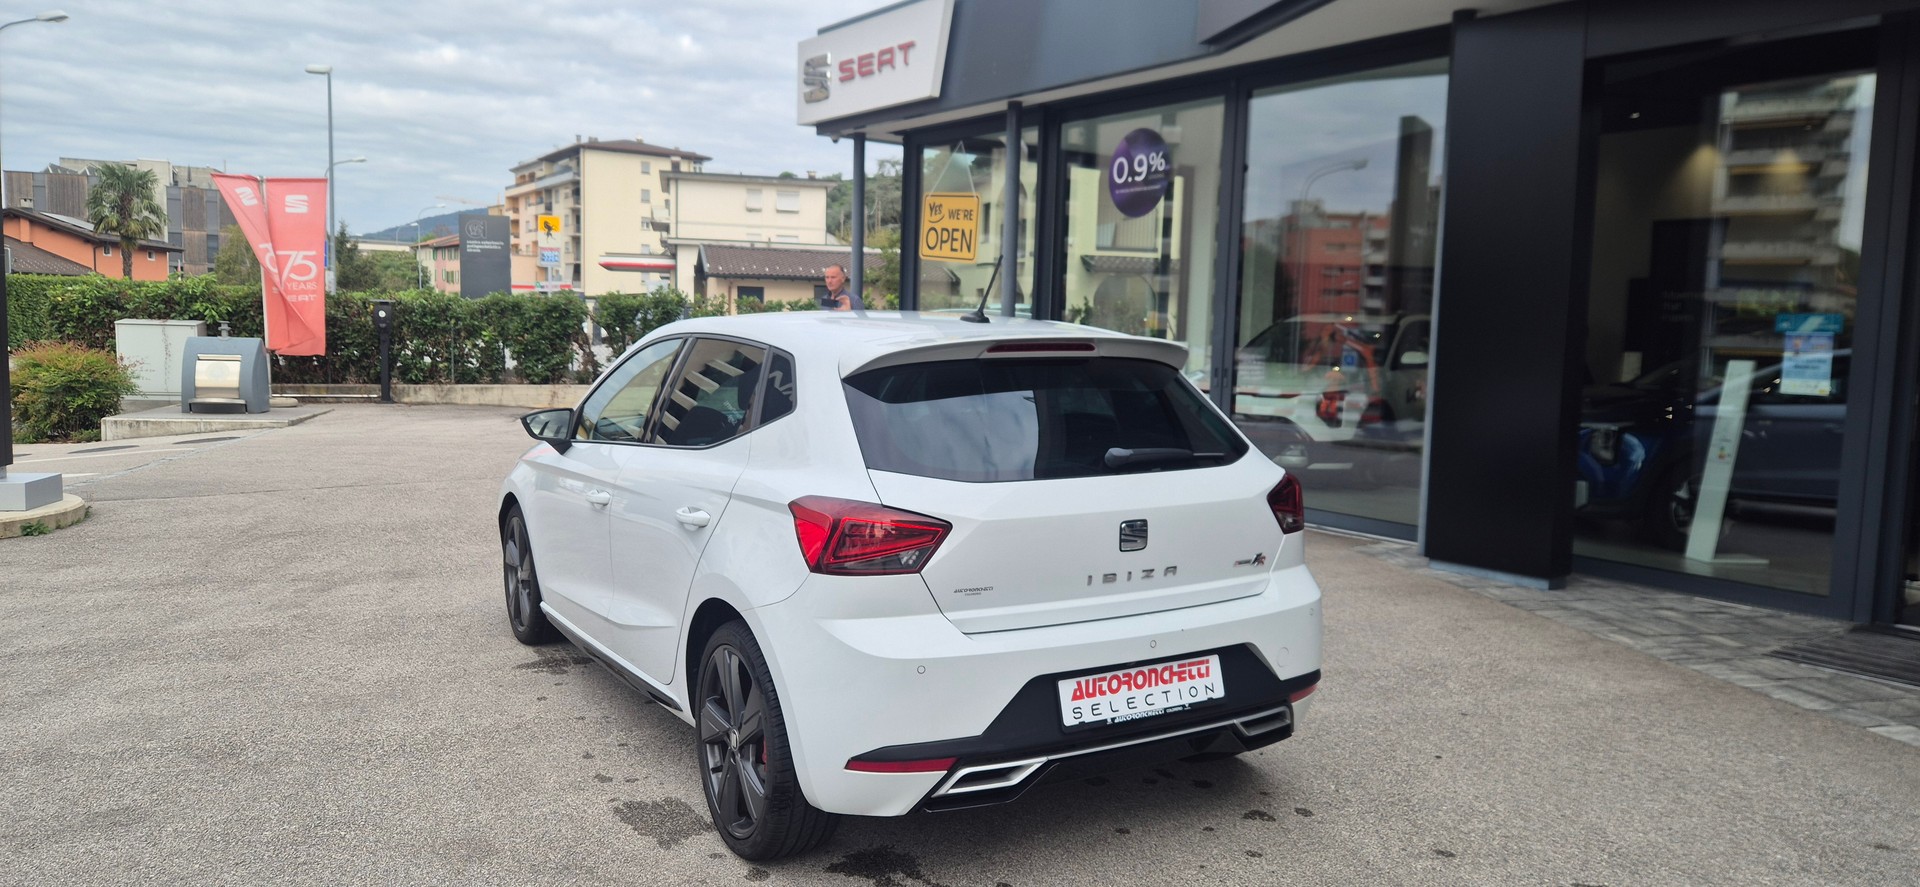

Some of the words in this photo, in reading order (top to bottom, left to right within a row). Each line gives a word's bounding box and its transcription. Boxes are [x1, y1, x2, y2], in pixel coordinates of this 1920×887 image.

[838, 40, 916, 83] SEAT
[1112, 151, 1166, 184] 0.9%
[929, 202, 943, 217] YES
[925, 226, 973, 253] OPEN
[275, 250, 318, 289] 75
[286, 281, 318, 291] YEARS
[287, 294, 318, 302] EAT
[1087, 565, 1178, 586] IBIZA
[1071, 659, 1211, 702] AUTORONCHETTI
[1072, 682, 1216, 720] SELECTION
